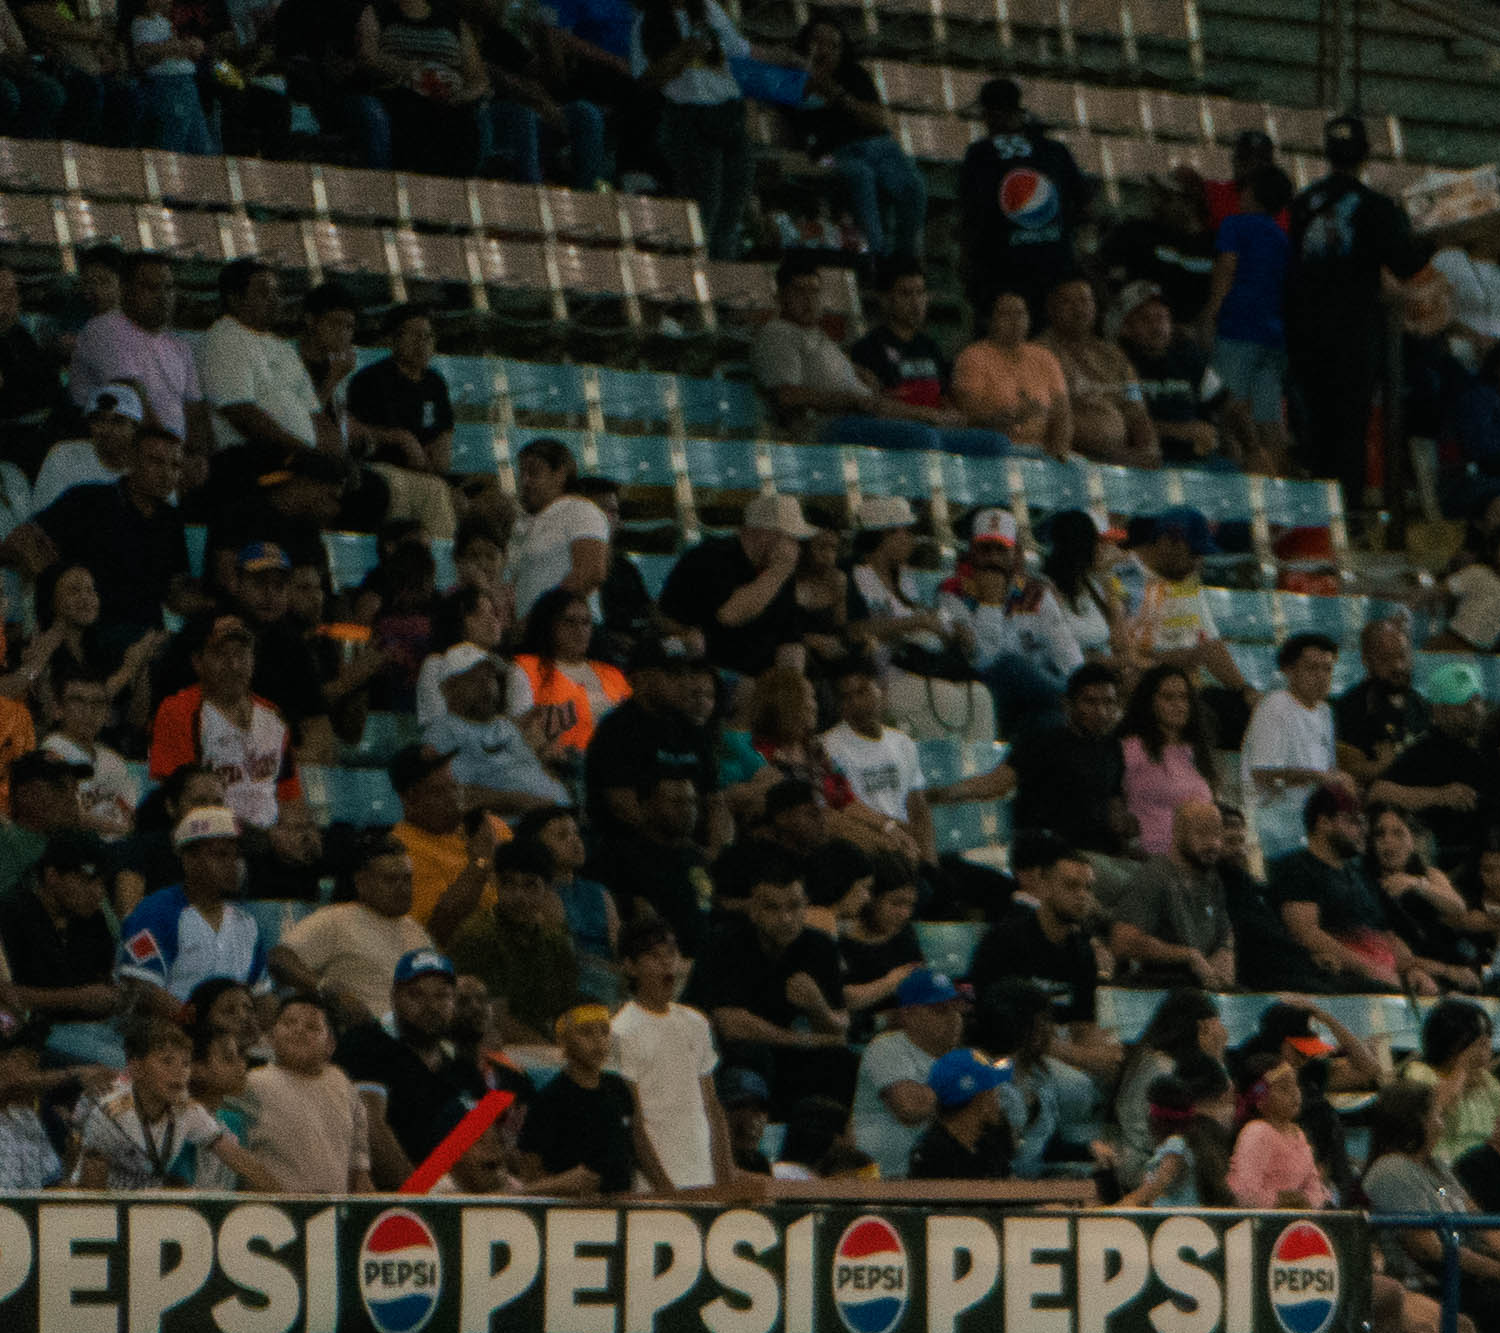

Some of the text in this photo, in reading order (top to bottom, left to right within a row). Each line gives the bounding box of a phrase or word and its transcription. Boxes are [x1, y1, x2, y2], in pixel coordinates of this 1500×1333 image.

[365, 1261, 436, 1288] PEPSI
[836, 1264, 905, 1291] PEPSI
[1273, 1265, 1335, 1293] PEPSI
